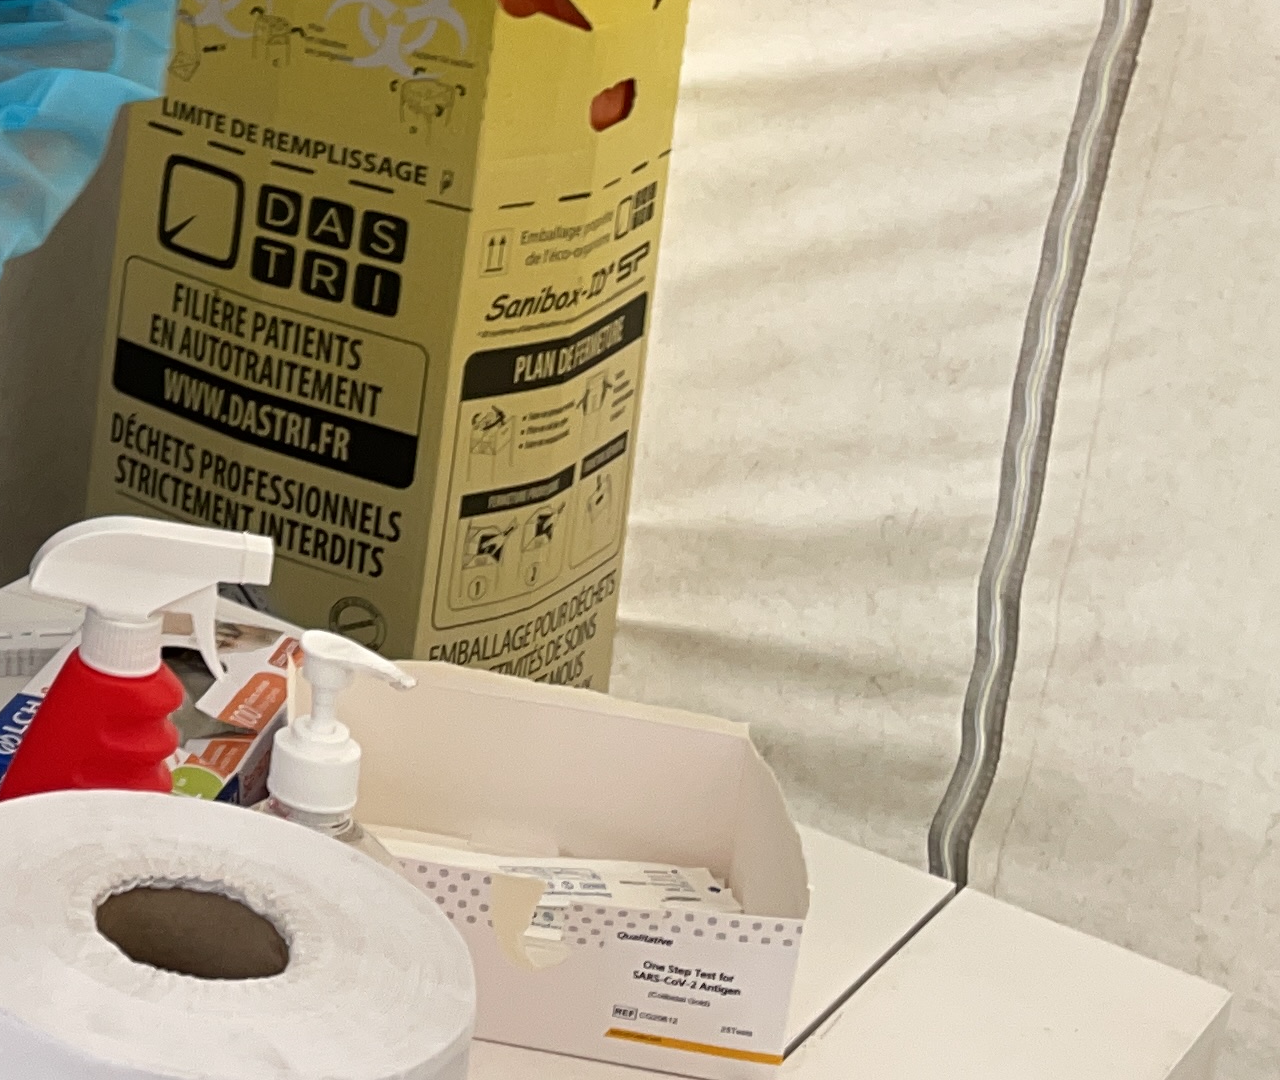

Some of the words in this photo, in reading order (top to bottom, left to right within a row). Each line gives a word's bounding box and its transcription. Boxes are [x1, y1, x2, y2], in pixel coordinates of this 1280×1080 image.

[162, 97, 227, 134] LIMITE
[230, 119, 258, 144] DE
[263, 128, 429, 187] REMPLISSAGE
[172, 282, 247, 338] FILIÈRE
[250, 311, 363, 371] PATIENTS
[149, 313, 176, 352] EN
[179, 326, 383, 418] AUTOTRAITEMENT
[513, 350, 557, 384] PLAN
[163, 368, 352, 462] WWW.DASTRI.FR
[110, 411, 195, 472] DÉCHETS
[199, 449, 403, 543] PROFESSIONNELS
[115, 454, 254, 532] STRICTEMENT
[260, 511, 384, 579] INTERDITS
[429, 621, 532, 666] EMBALLAGE
[533, 602, 570, 642] POUR
[617, 931, 673, 947] Qualitative
[643, 960, 665, 973] One
[668, 965, 691, 977] Step
[695, 969, 716, 981] Test
[719, 972, 734, 983] for
[613, 1006, 636, 1019] REF
[633, 970, 697, 989] SARS-CoV-2
[699, 981, 741, 997] Antigen
